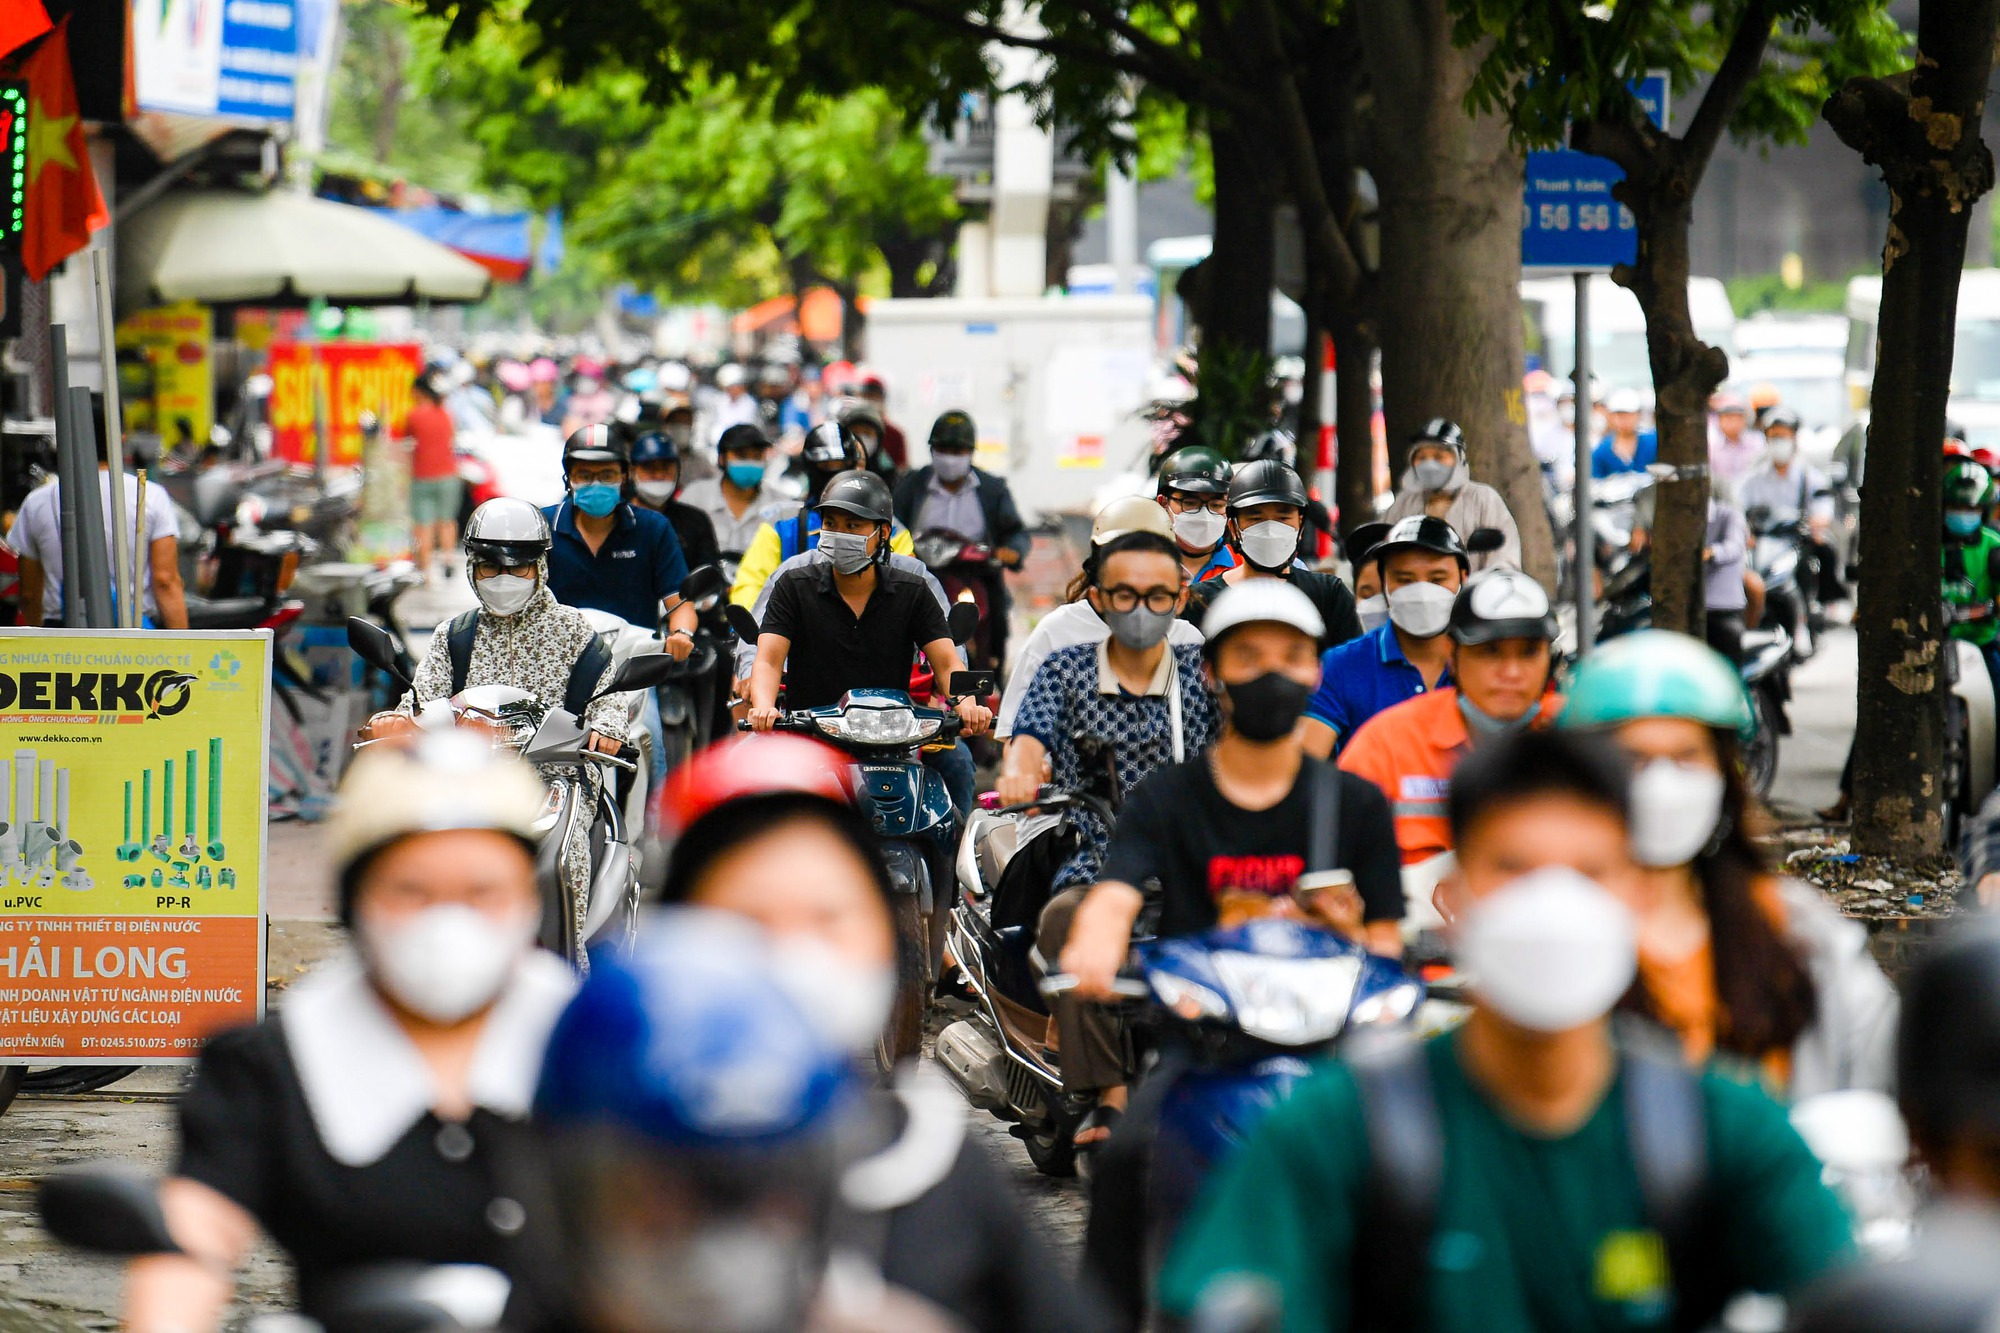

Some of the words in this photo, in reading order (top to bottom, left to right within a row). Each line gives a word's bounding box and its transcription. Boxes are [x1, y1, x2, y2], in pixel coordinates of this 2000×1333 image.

[12, 652, 50, 666] NHỰA
[19, 734, 102, 743] www.dekko.com.vn
[4, 896, 42, 908] u.PVC
[156, 896, 191, 908] PP-R
[17, 921, 33, 932] TY
[36, 921, 72, 932] TNHH
[75, 918, 112, 932] THIẾT
[114, 921, 127, 935] BỊ
[129, 919, 160, 935] ĐIỆN
[163, 920, 201, 933] NƯỚC
[0, 936, 60, 978] HẢI
[73, 946, 186, 979] LONG
[22, 988, 70, 1002] DOANH
[73, 986, 99, 1006] VẬT
[101, 987, 119, 1002] TƯ
[121, 987, 168, 1002] NGÀNH
[170, 987, 201, 1006] ĐIỆN
[204, 987, 242, 1003] NƯỚC
[0, 1007, 19, 1027] ẬT
[21, 1007, 49, 1027] LIỆU
[52, 1008, 78, 1024] XÂY
[81, 1008, 120, 1027] DỰNG
[122, 1008, 148, 1024] CÁC
[151, 1010, 180, 1028] LOẠI
[81, 1037, 98, 1048] ĐT:
[100, 1037, 166, 1048] 0245.510.075
